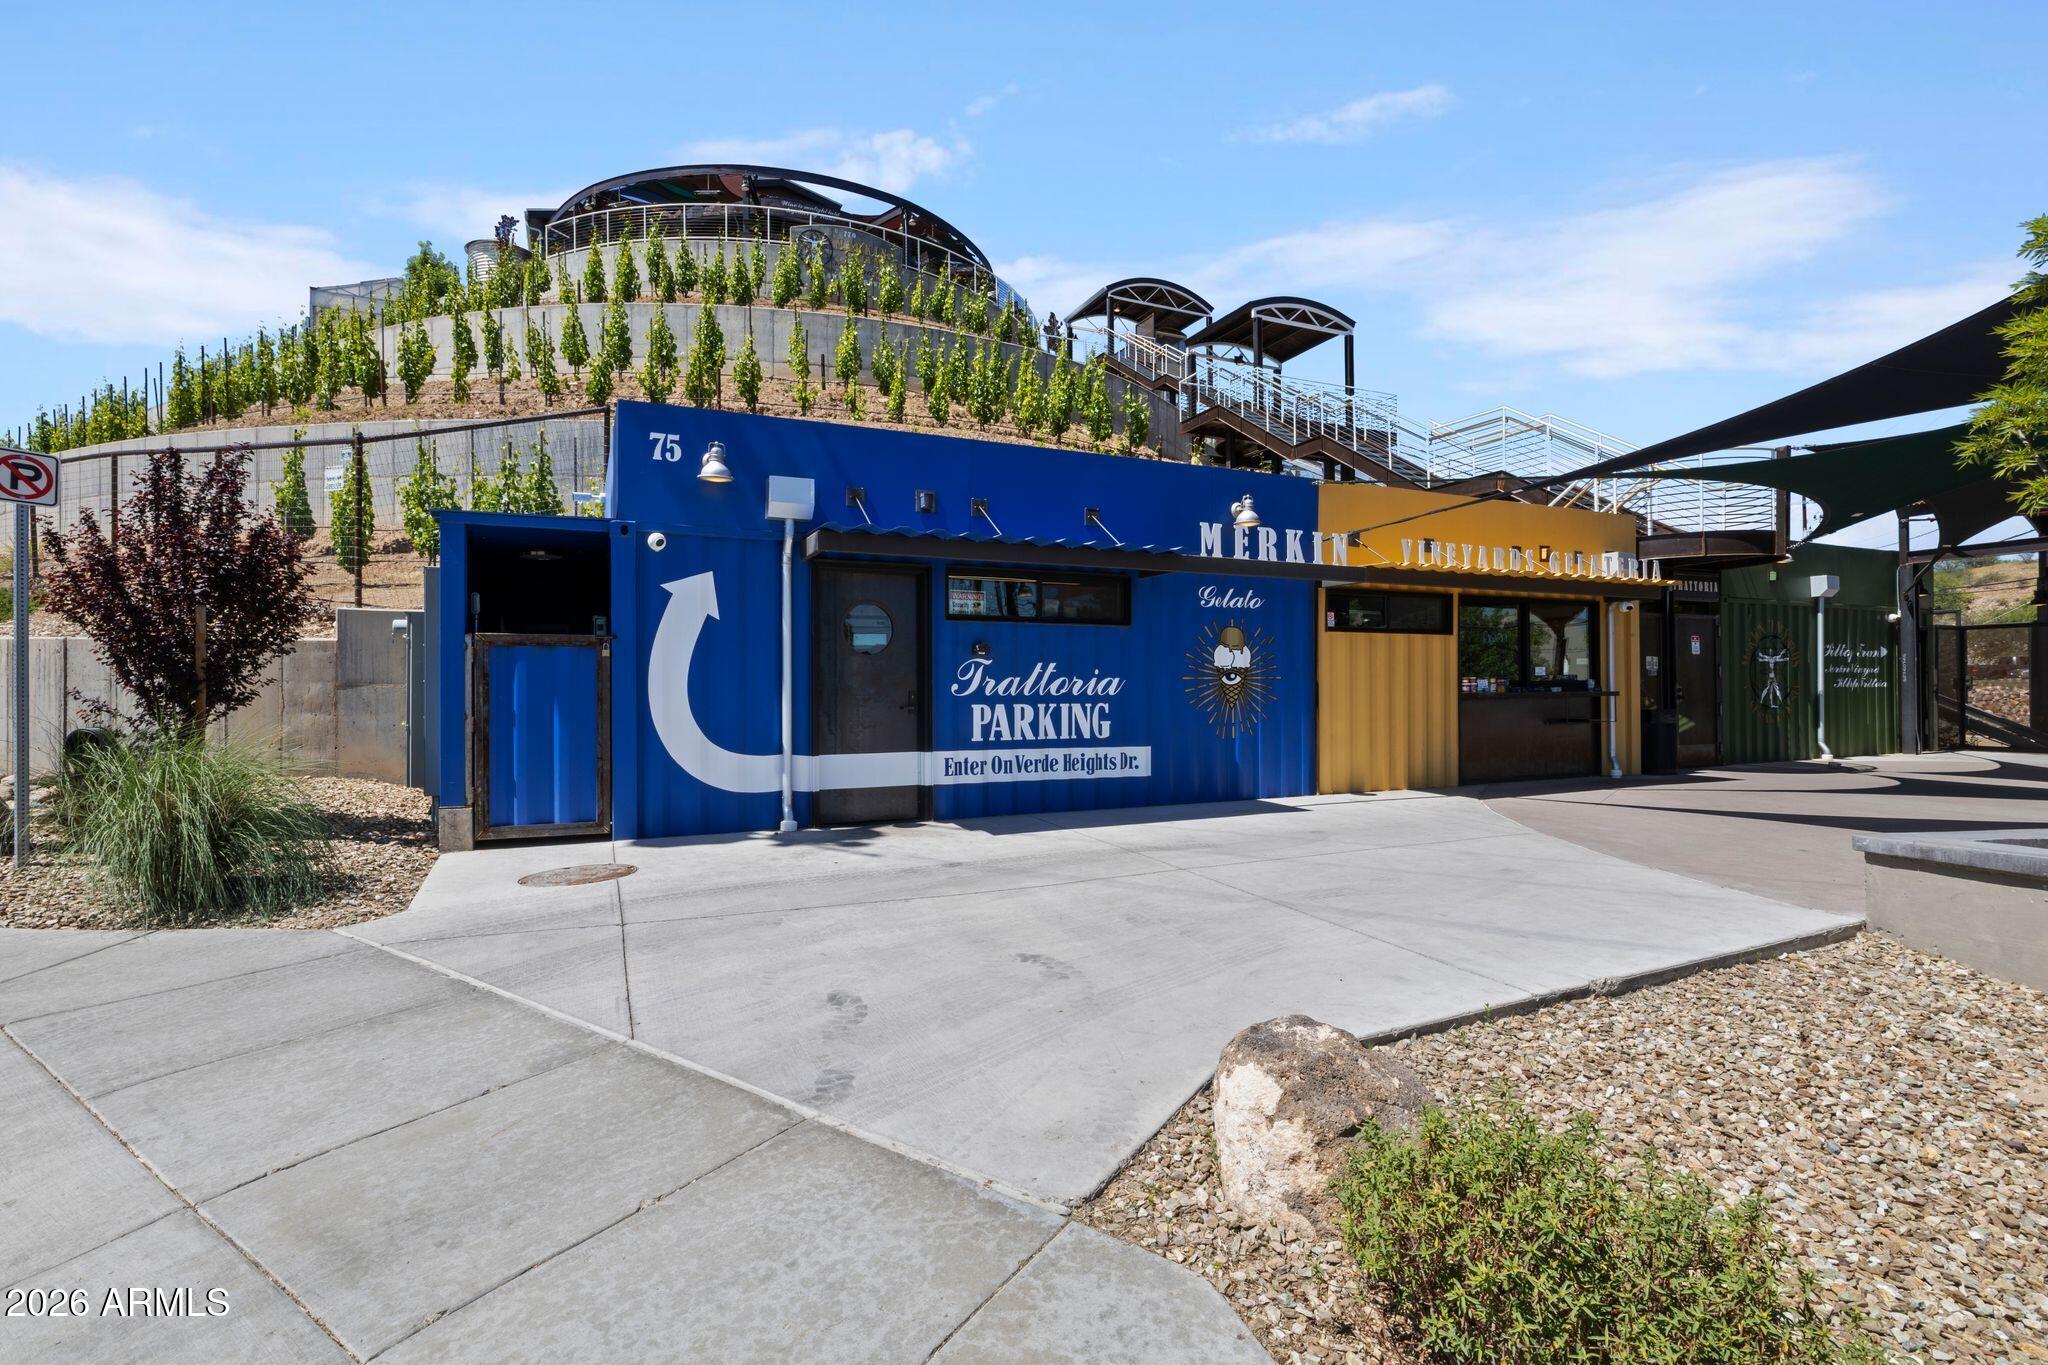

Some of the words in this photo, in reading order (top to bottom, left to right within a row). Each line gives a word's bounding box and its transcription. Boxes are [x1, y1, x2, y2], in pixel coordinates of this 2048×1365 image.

[649, 432, 682, 462] 75
[1200, 521, 1349, 567] MERKIN
[1400, 538, 1535, 572] VINEYARDS
[1549, 550, 1662, 583] GELATERIA
[1199, 585, 1266, 609] Gelato
[950, 657, 1126, 697] Trattoria
[971, 703, 1111, 742] PARKING
[944, 756, 987, 777] Enter
[991, 755, 1013, 775] On
[1015, 753, 1059, 774] Verde
[1063, 752, 1117, 776] Heights
[1120, 751, 1140, 770] Dr.
